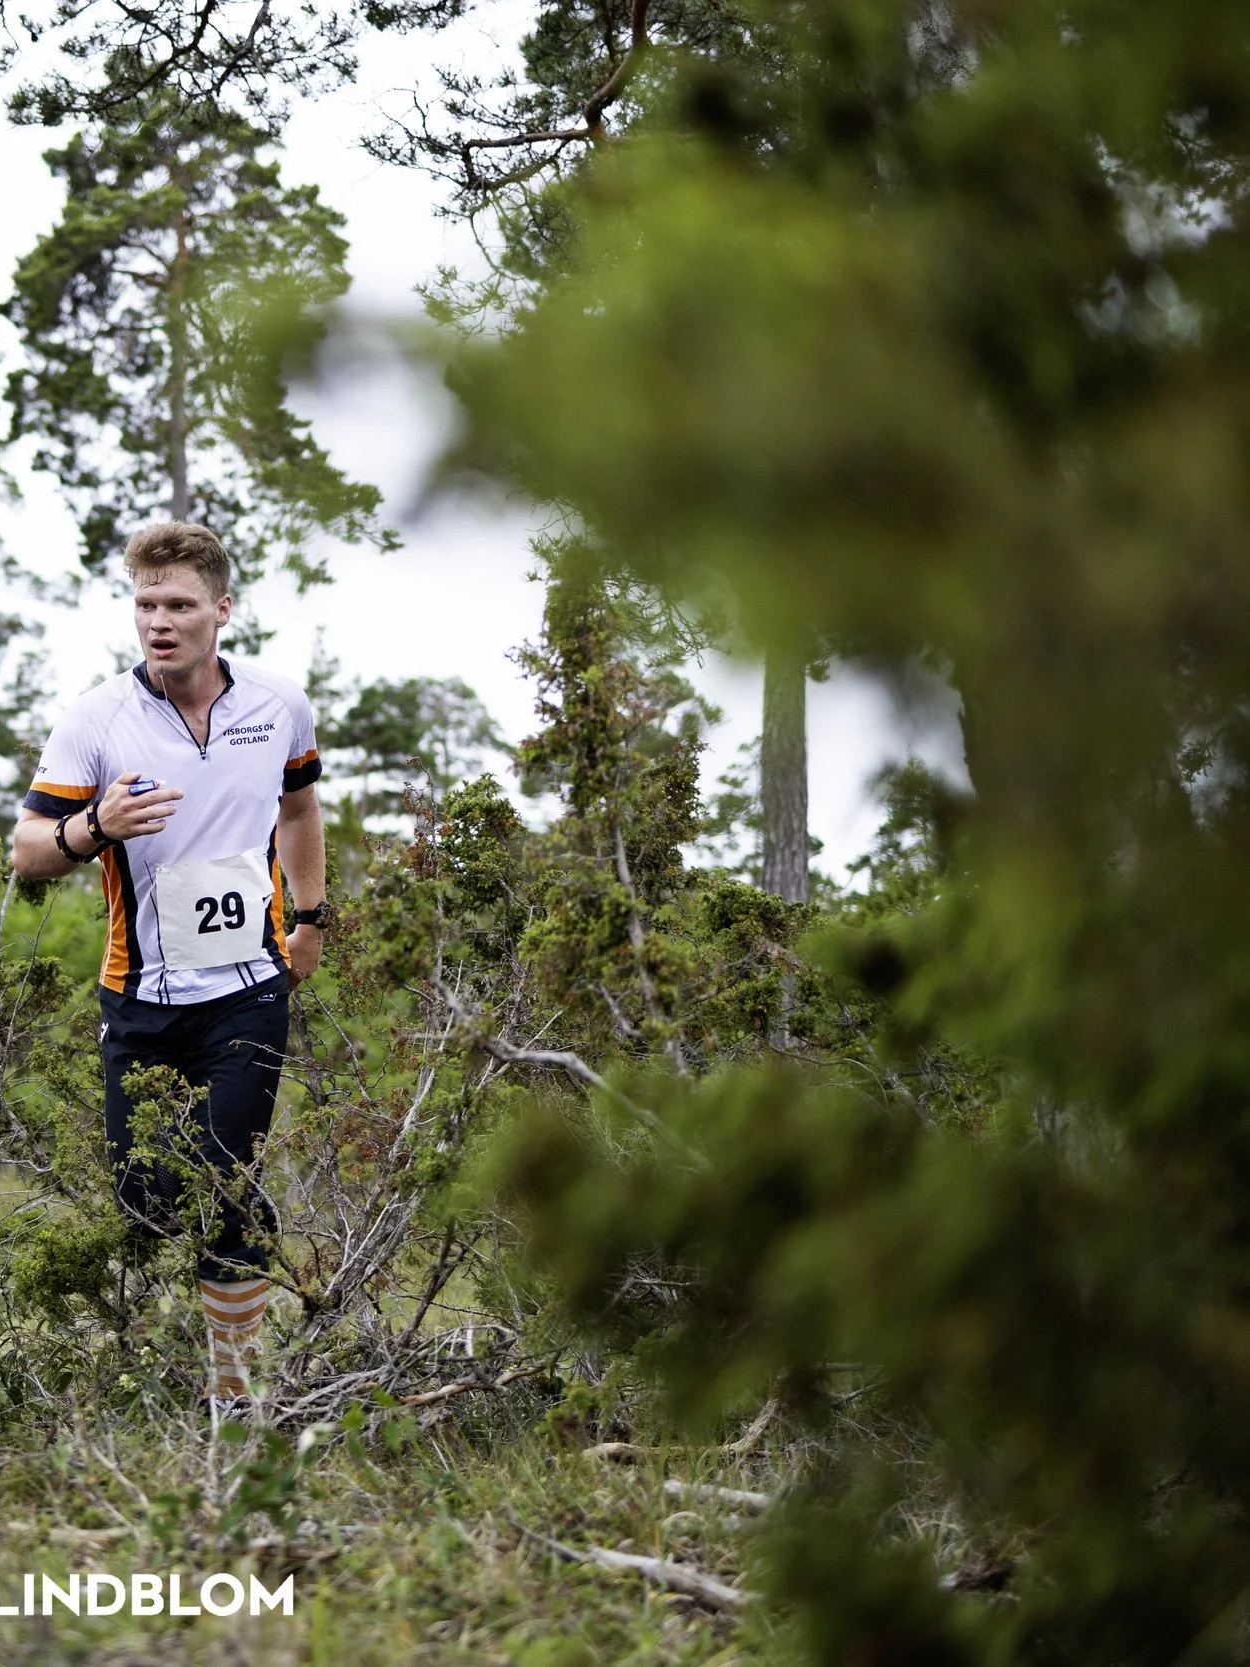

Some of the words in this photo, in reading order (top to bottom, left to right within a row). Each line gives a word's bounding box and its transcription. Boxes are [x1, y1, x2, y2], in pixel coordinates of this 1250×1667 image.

[264, 723, 275, 731] OK
[230, 735, 269, 745] GOTLAND
[195, 891, 246, 934] 29
